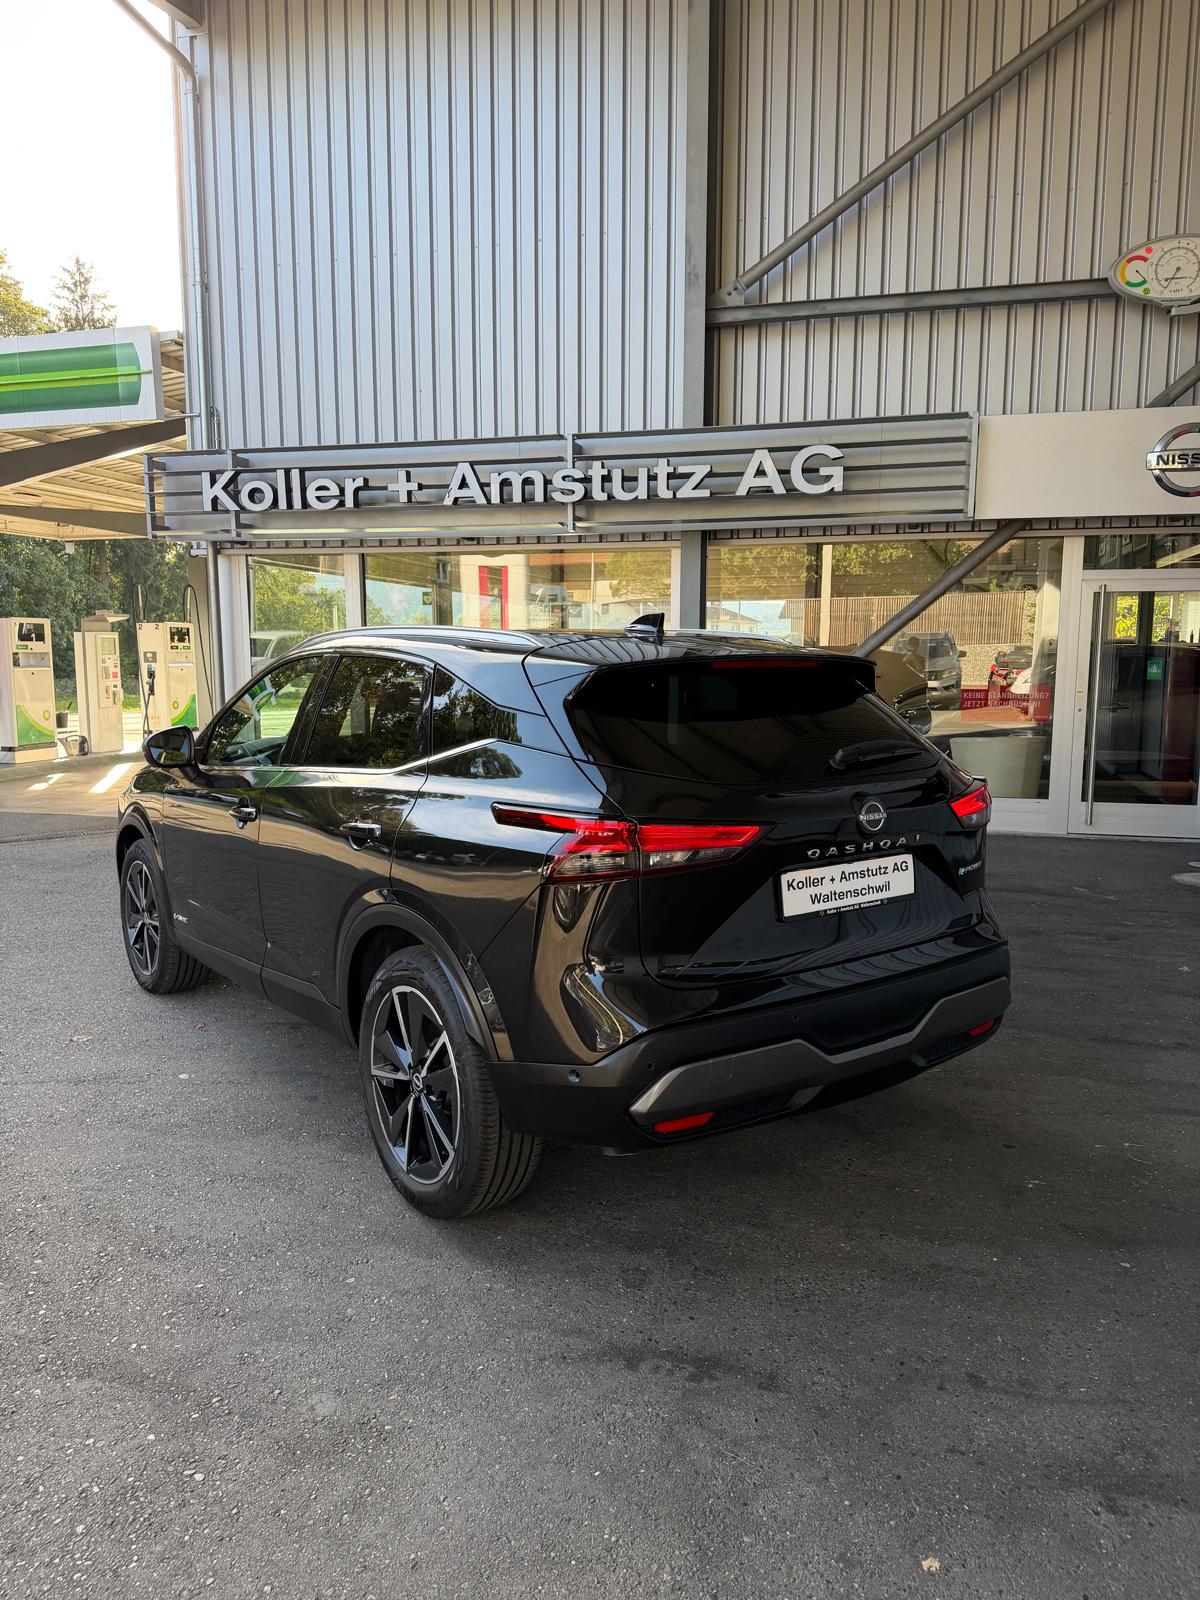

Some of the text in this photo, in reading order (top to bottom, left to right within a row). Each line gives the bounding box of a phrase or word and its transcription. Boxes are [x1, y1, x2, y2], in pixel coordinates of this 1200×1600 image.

[1156, 453, 1200, 466] NISS
[201, 444, 845, 511] Koller + Amstutz AG
[860, 812, 887, 821] NISSAN
[807, 834, 920, 859] QASHQAI
[786, 860, 909, 892] Koller + Amstutz AG
[809, 880, 891, 905] Waltenschwil
